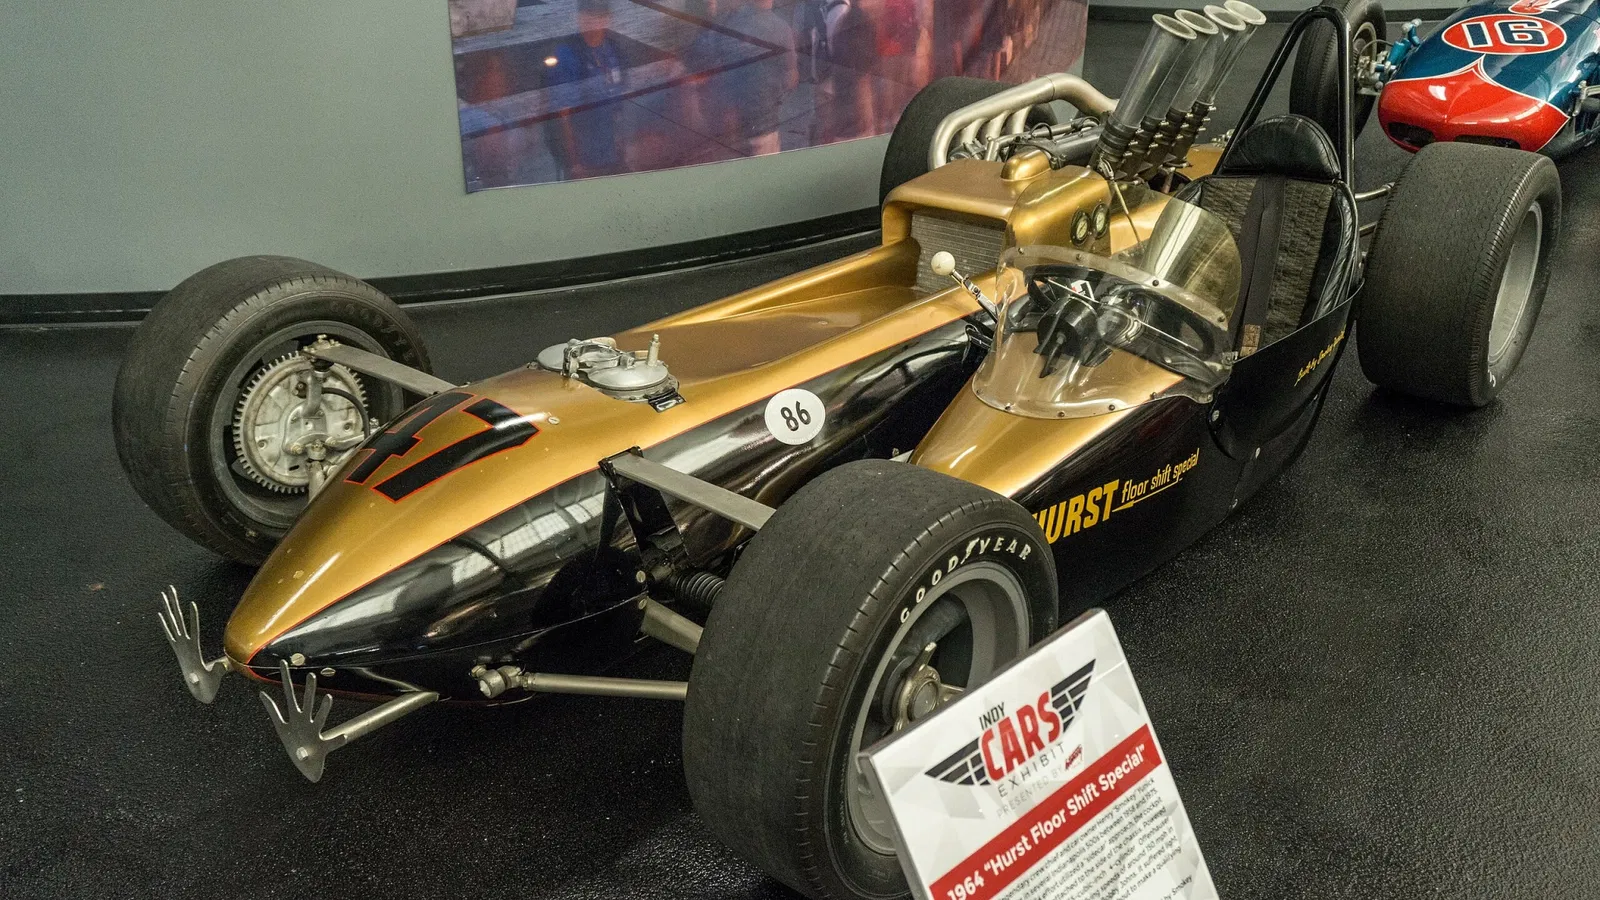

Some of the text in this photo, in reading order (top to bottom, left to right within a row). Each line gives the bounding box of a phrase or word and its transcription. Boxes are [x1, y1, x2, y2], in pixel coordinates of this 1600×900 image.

[1462, 20, 1549, 48] 16
[780, 400, 812, 432] 86
[344, 392, 541, 502] 47
[1121, 480, 1150, 504] floor
[1151, 466, 1172, 490] shift
[1172, 447, 1200, 483] special
[900, 537, 1032, 624] GOODYEAR
[978, 702, 1006, 731] INDY
[980, 690, 1062, 782] CARS
[996, 766, 1063, 818] PRESENTED BY
[997, 742, 1065, 797] EXHIBIT
[946, 870, 984, 900] 1964
[983, 835, 1032, 876] “Hurst
[1030, 808, 1067, 845] Floor
[1066, 782, 1100, 816] Shift
[1098, 743, 1145, 791] Special”
